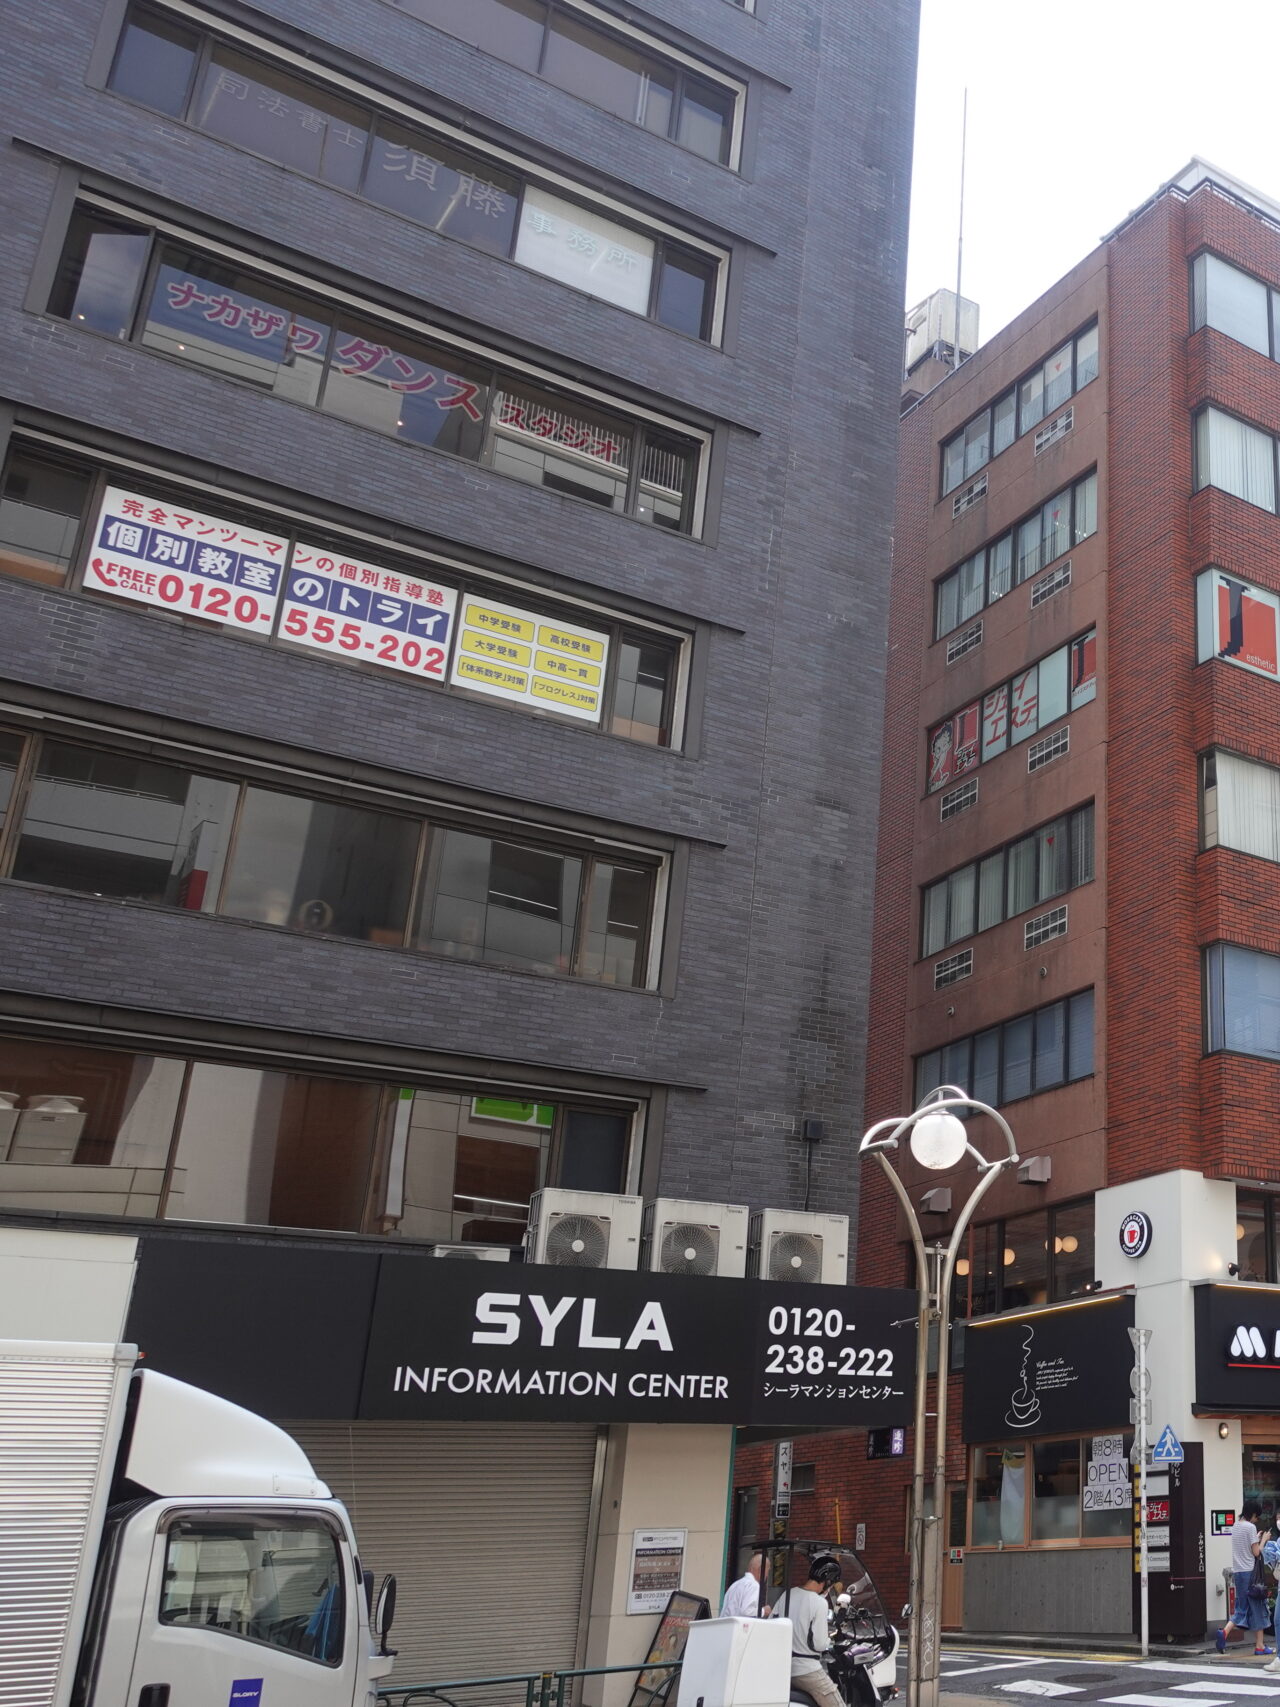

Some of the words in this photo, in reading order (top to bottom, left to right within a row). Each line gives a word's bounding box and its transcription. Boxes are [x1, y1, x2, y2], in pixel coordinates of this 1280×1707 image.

[216, 75, 364, 150] 司法書士
[382, 142, 507, 219] 須藤
[166, 280, 323, 354] ナカザワ
[336, 337, 483, 423] ダンス
[497, 402, 620, 463] スタジオ
[105, 562, 157, 587] FREE
[121, 579, 154, 597] CALL
[479, 614, 522, 633] 中学受験
[475, 640, 518, 659] 大学受験
[550, 634, 591, 653] 高校受験
[547, 660, 588, 679] 中高一貫
[1246, 653, 1276, 672] esthetic
[472, 1291, 674, 1352] SYLA
[768, 1305, 856, 1339] 0120-
[765, 1343, 894, 1378] 238-222
[393, 1366, 617, 1396] INFORMATION
[628, 1373, 729, 1400] CENTER
[762, 1381, 904, 1400] シーラマンションセンター
[1093, 1438, 1123, 1458] 朝8時
[1088, 1463, 1129, 1483] OPEN
[1084, 1486, 1133, 1510] 2階43席
